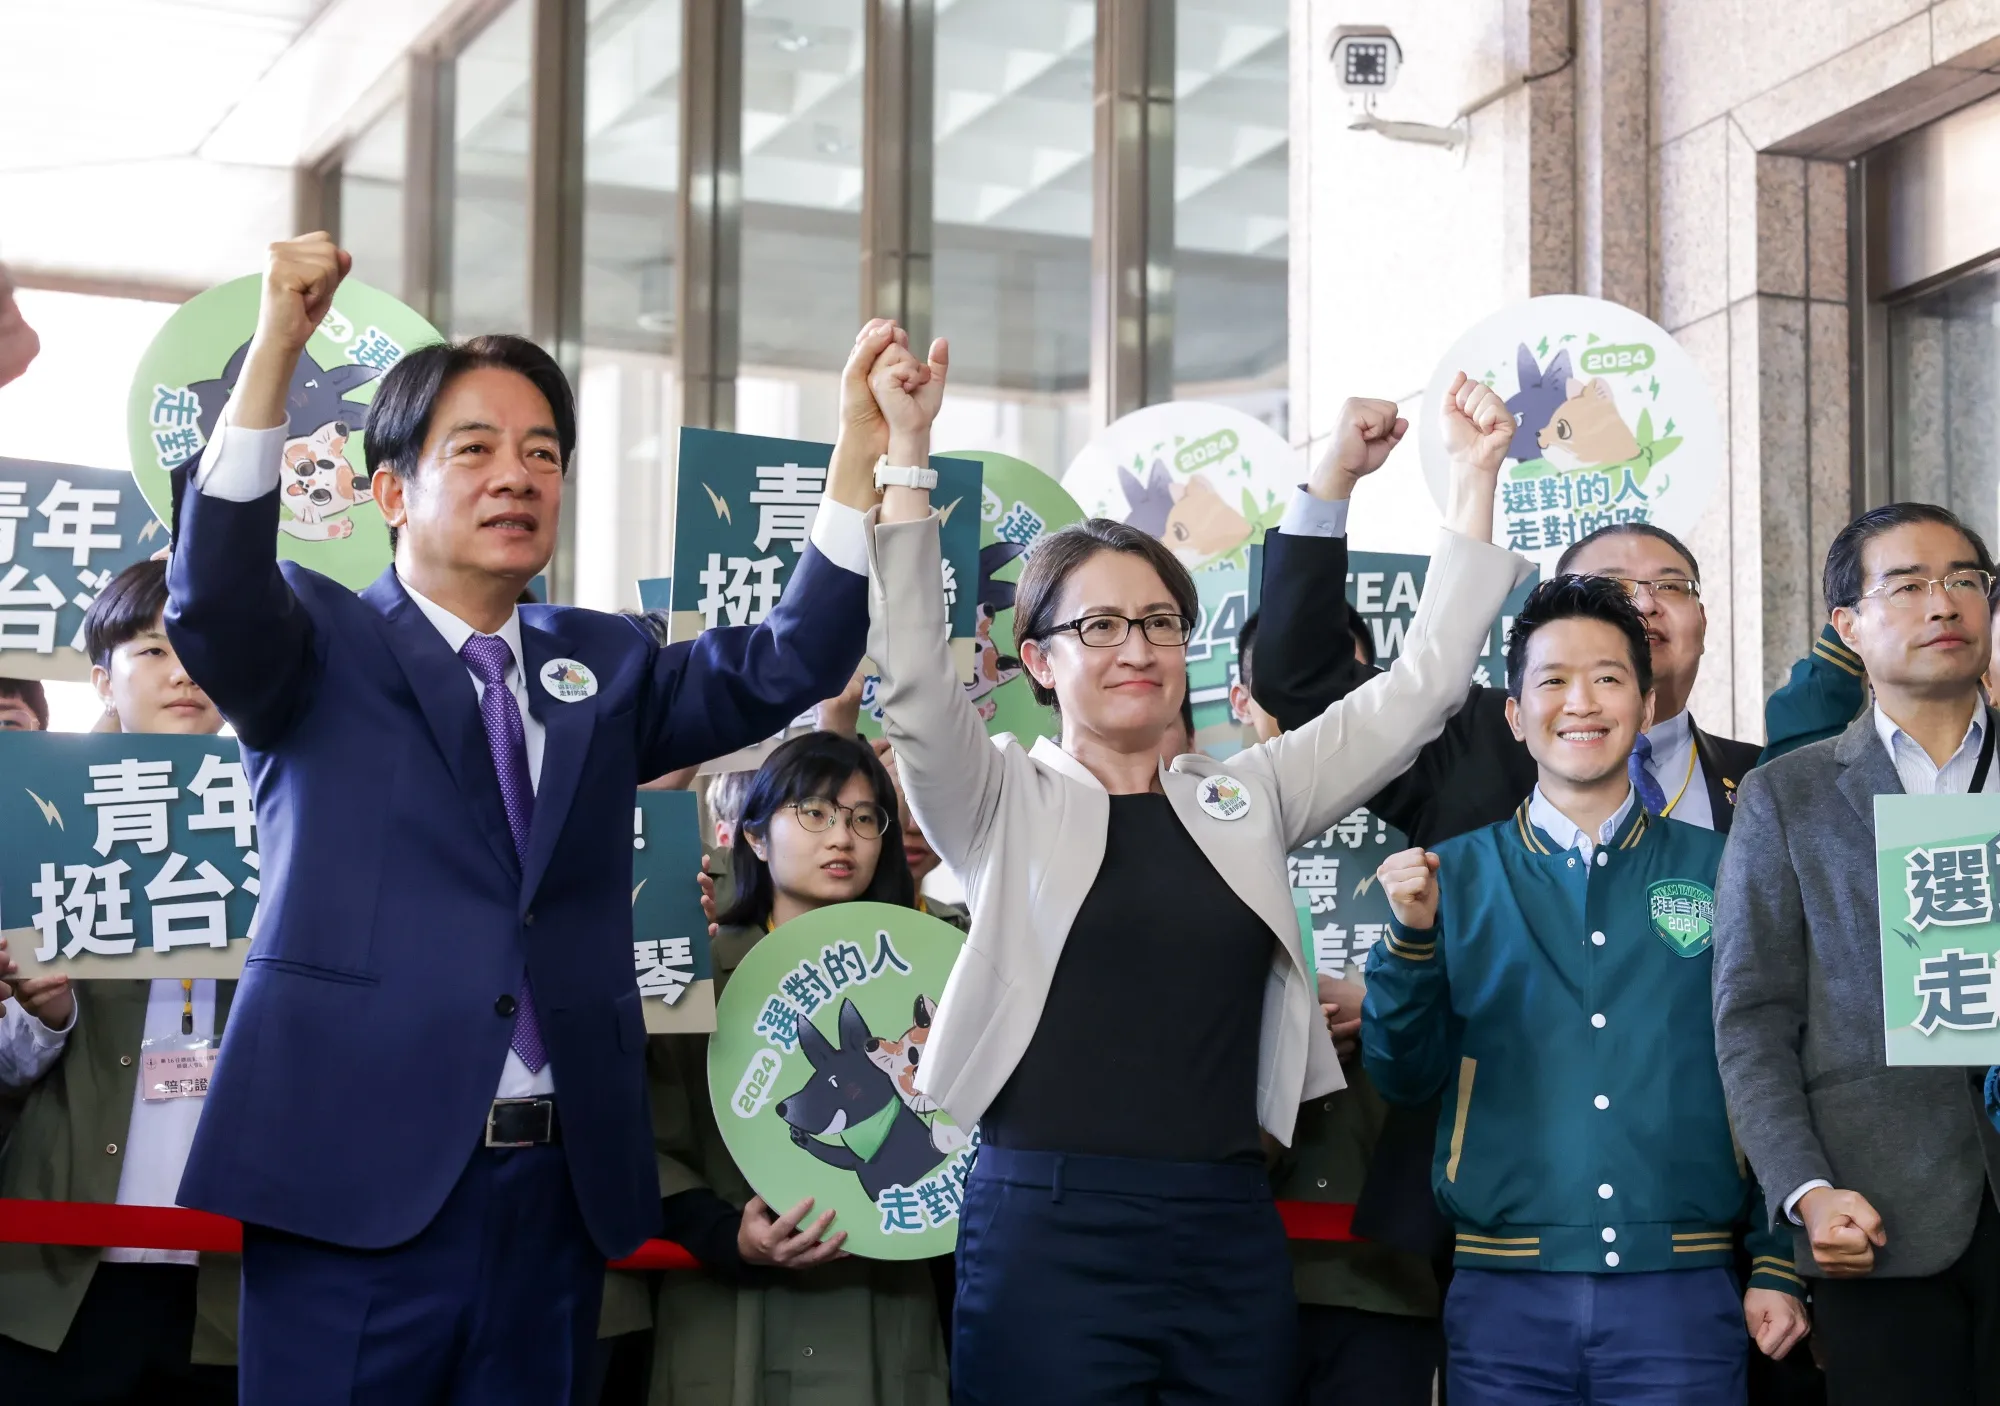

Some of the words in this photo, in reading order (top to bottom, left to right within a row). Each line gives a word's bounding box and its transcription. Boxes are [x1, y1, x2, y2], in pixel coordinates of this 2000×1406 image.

[1587, 349, 1648, 370] 2024
[1179, 434, 1234, 470] 2024
[1502, 468, 1649, 515] 選對的人
[0, 564, 113, 654] 台
[1346, 571, 1431, 613] EA
[84, 754, 257, 858] 青年
[1303, 806, 1387, 849] 持!
[32, 850, 259, 962] 挺台
[1651, 896, 1713, 926] 挺台灣
[1653, 884, 1678, 898] TEAM
[1678, 884, 1712, 903] TAIWAN
[1668, 916, 1699, 933] 2024
[757, 933, 910, 1050] 選對的人
[738, 1055, 777, 1124] 2024
